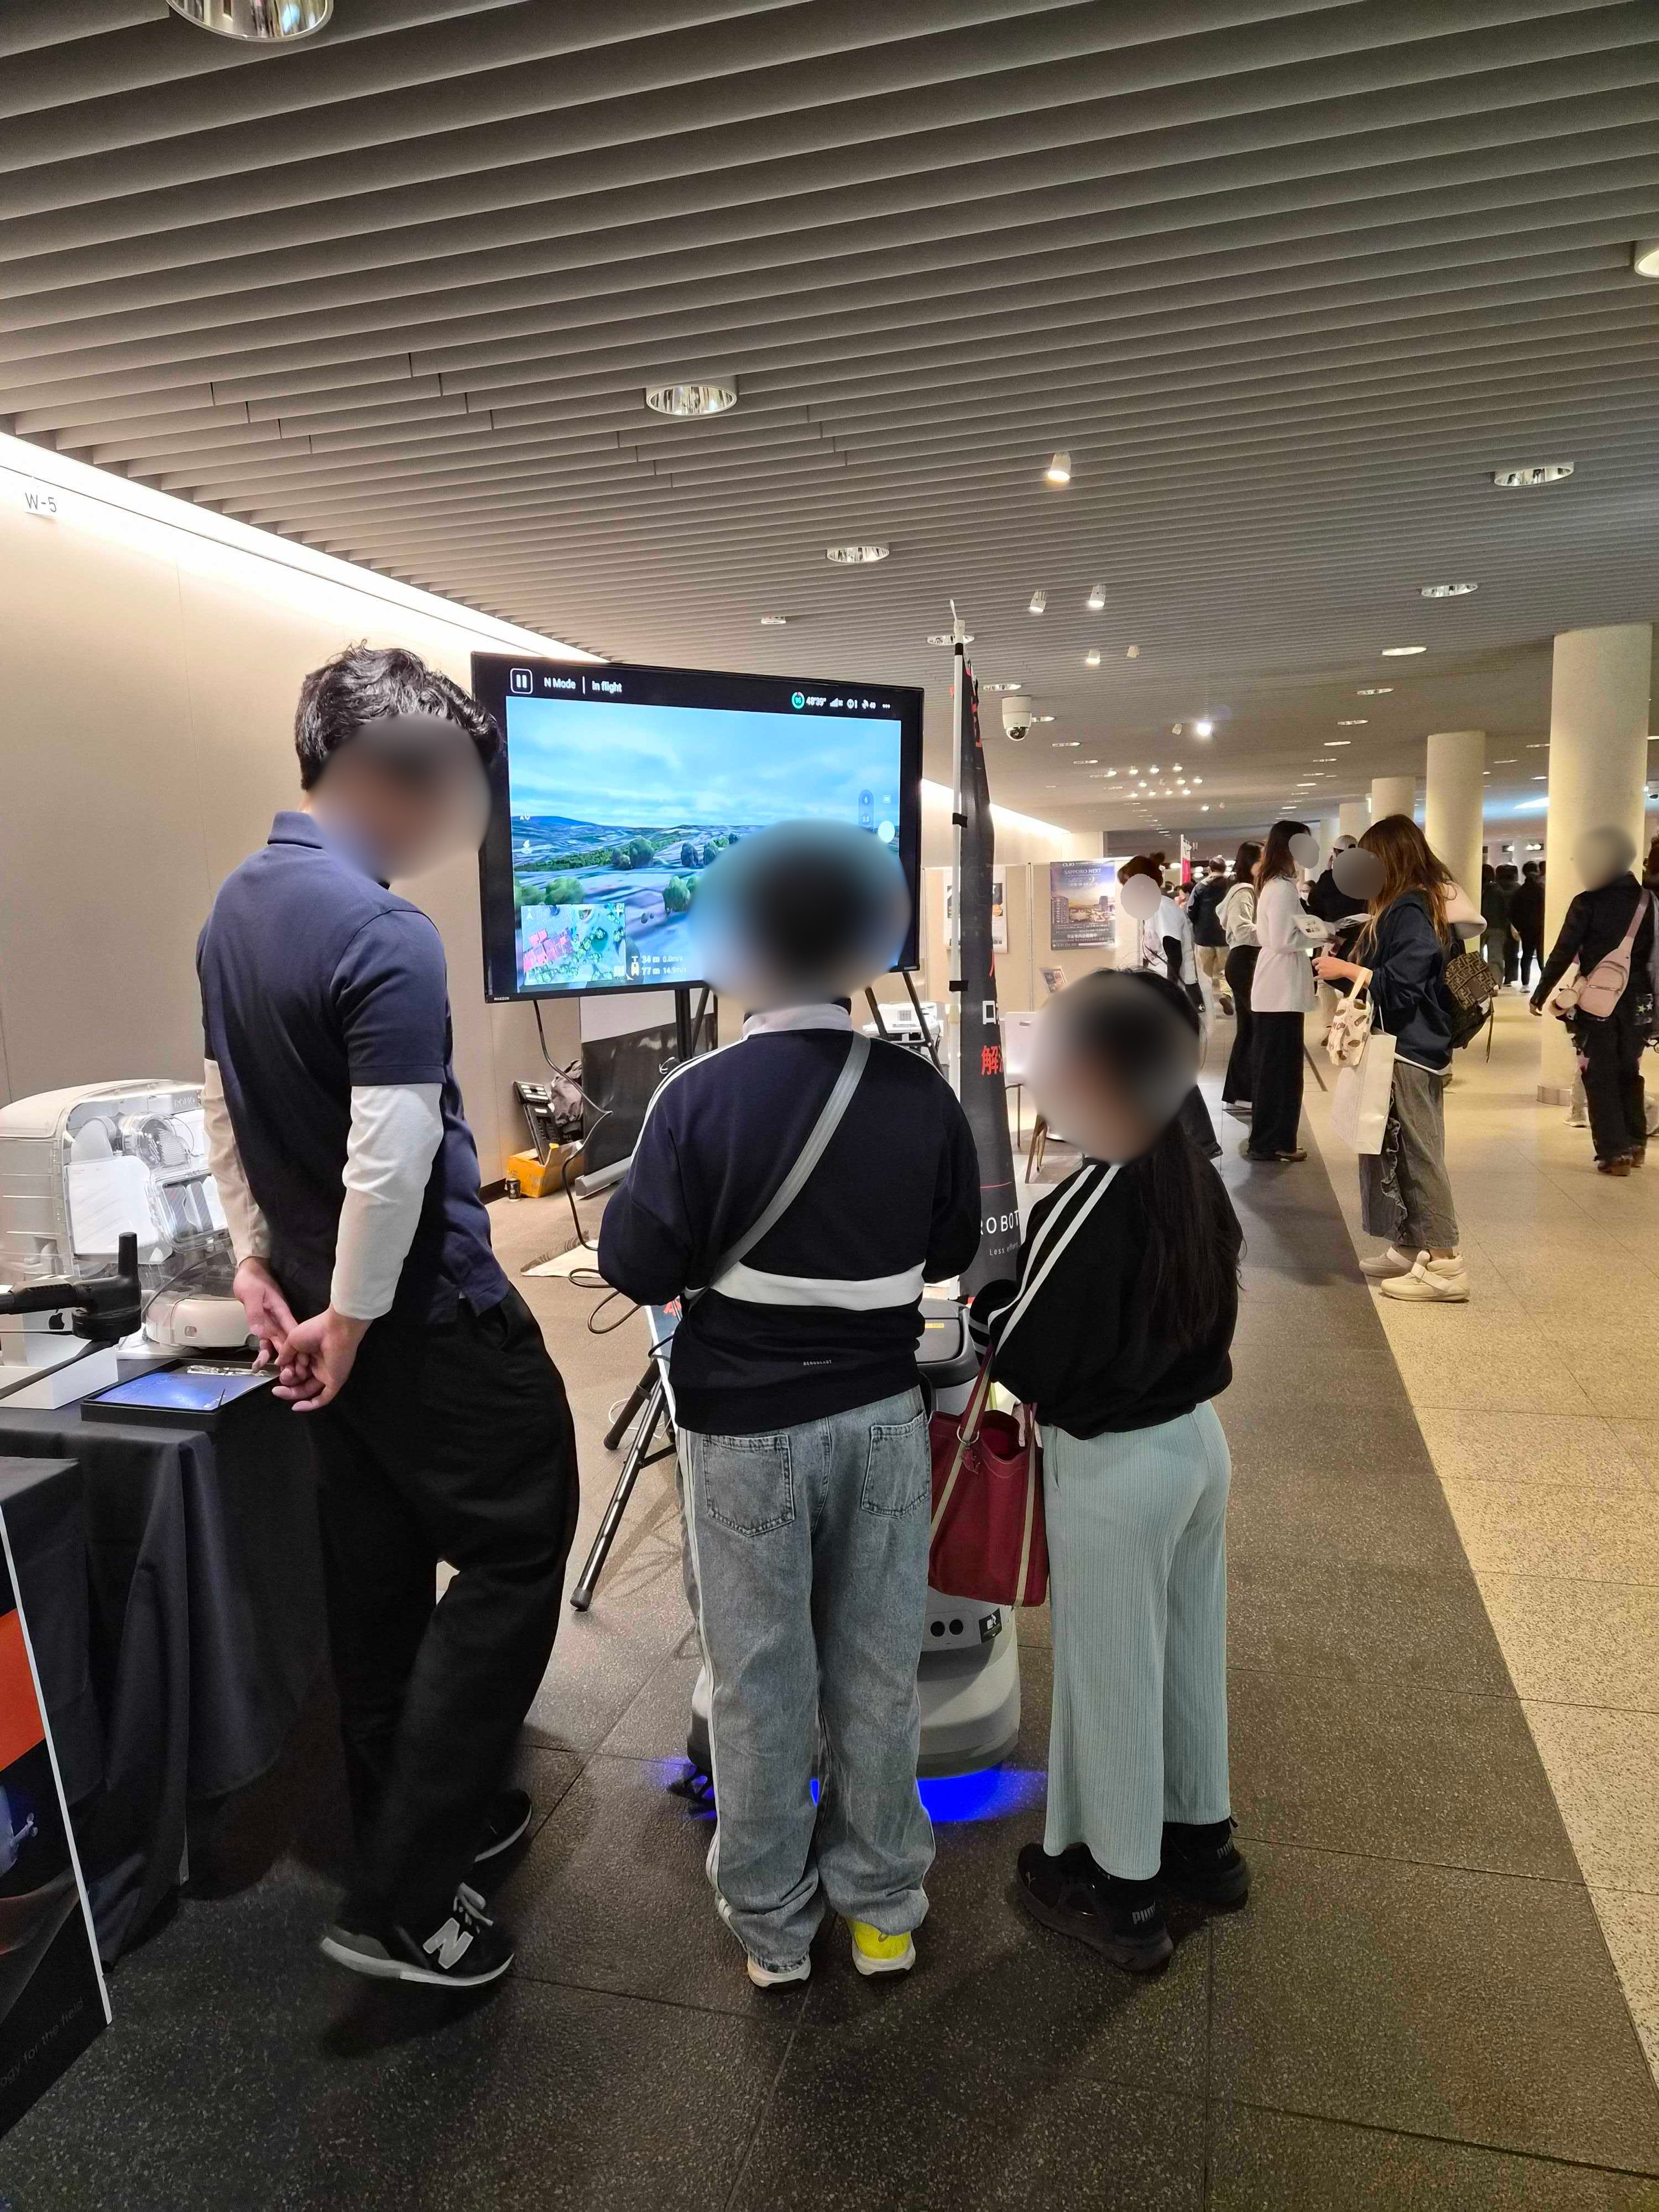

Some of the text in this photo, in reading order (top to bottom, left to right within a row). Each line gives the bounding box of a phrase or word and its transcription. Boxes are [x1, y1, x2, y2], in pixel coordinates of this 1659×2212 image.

[25, 493, 57, 513] W-5
[544, 677, 576, 690] N Mode
[601, 681, 623, 693] flight
[980, 1209, 1019, 1235] OBOT
